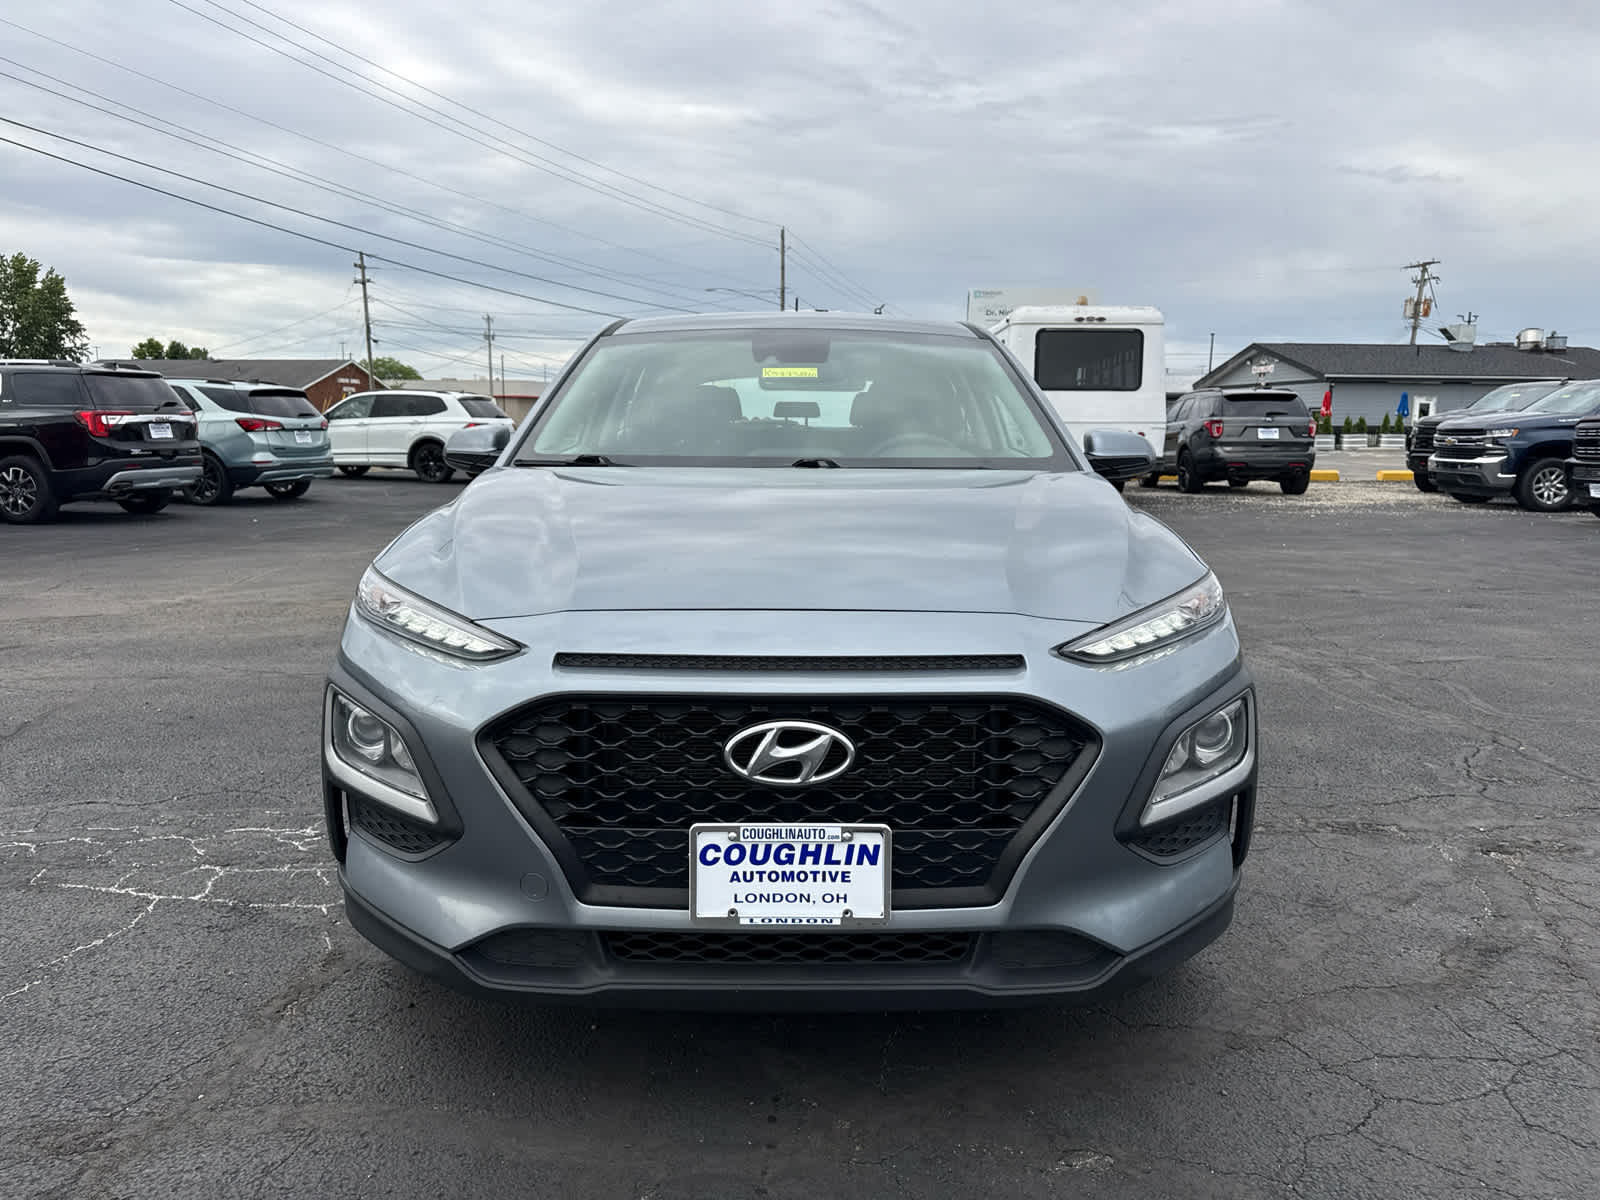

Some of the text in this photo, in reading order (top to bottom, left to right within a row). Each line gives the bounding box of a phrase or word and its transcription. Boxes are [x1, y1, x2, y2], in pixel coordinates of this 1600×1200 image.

[699, 843, 880, 866] COUGHLIN
[729, 871, 851, 883] AUTOMOTIVE
[734, 893, 848, 905] LONDON, OH
